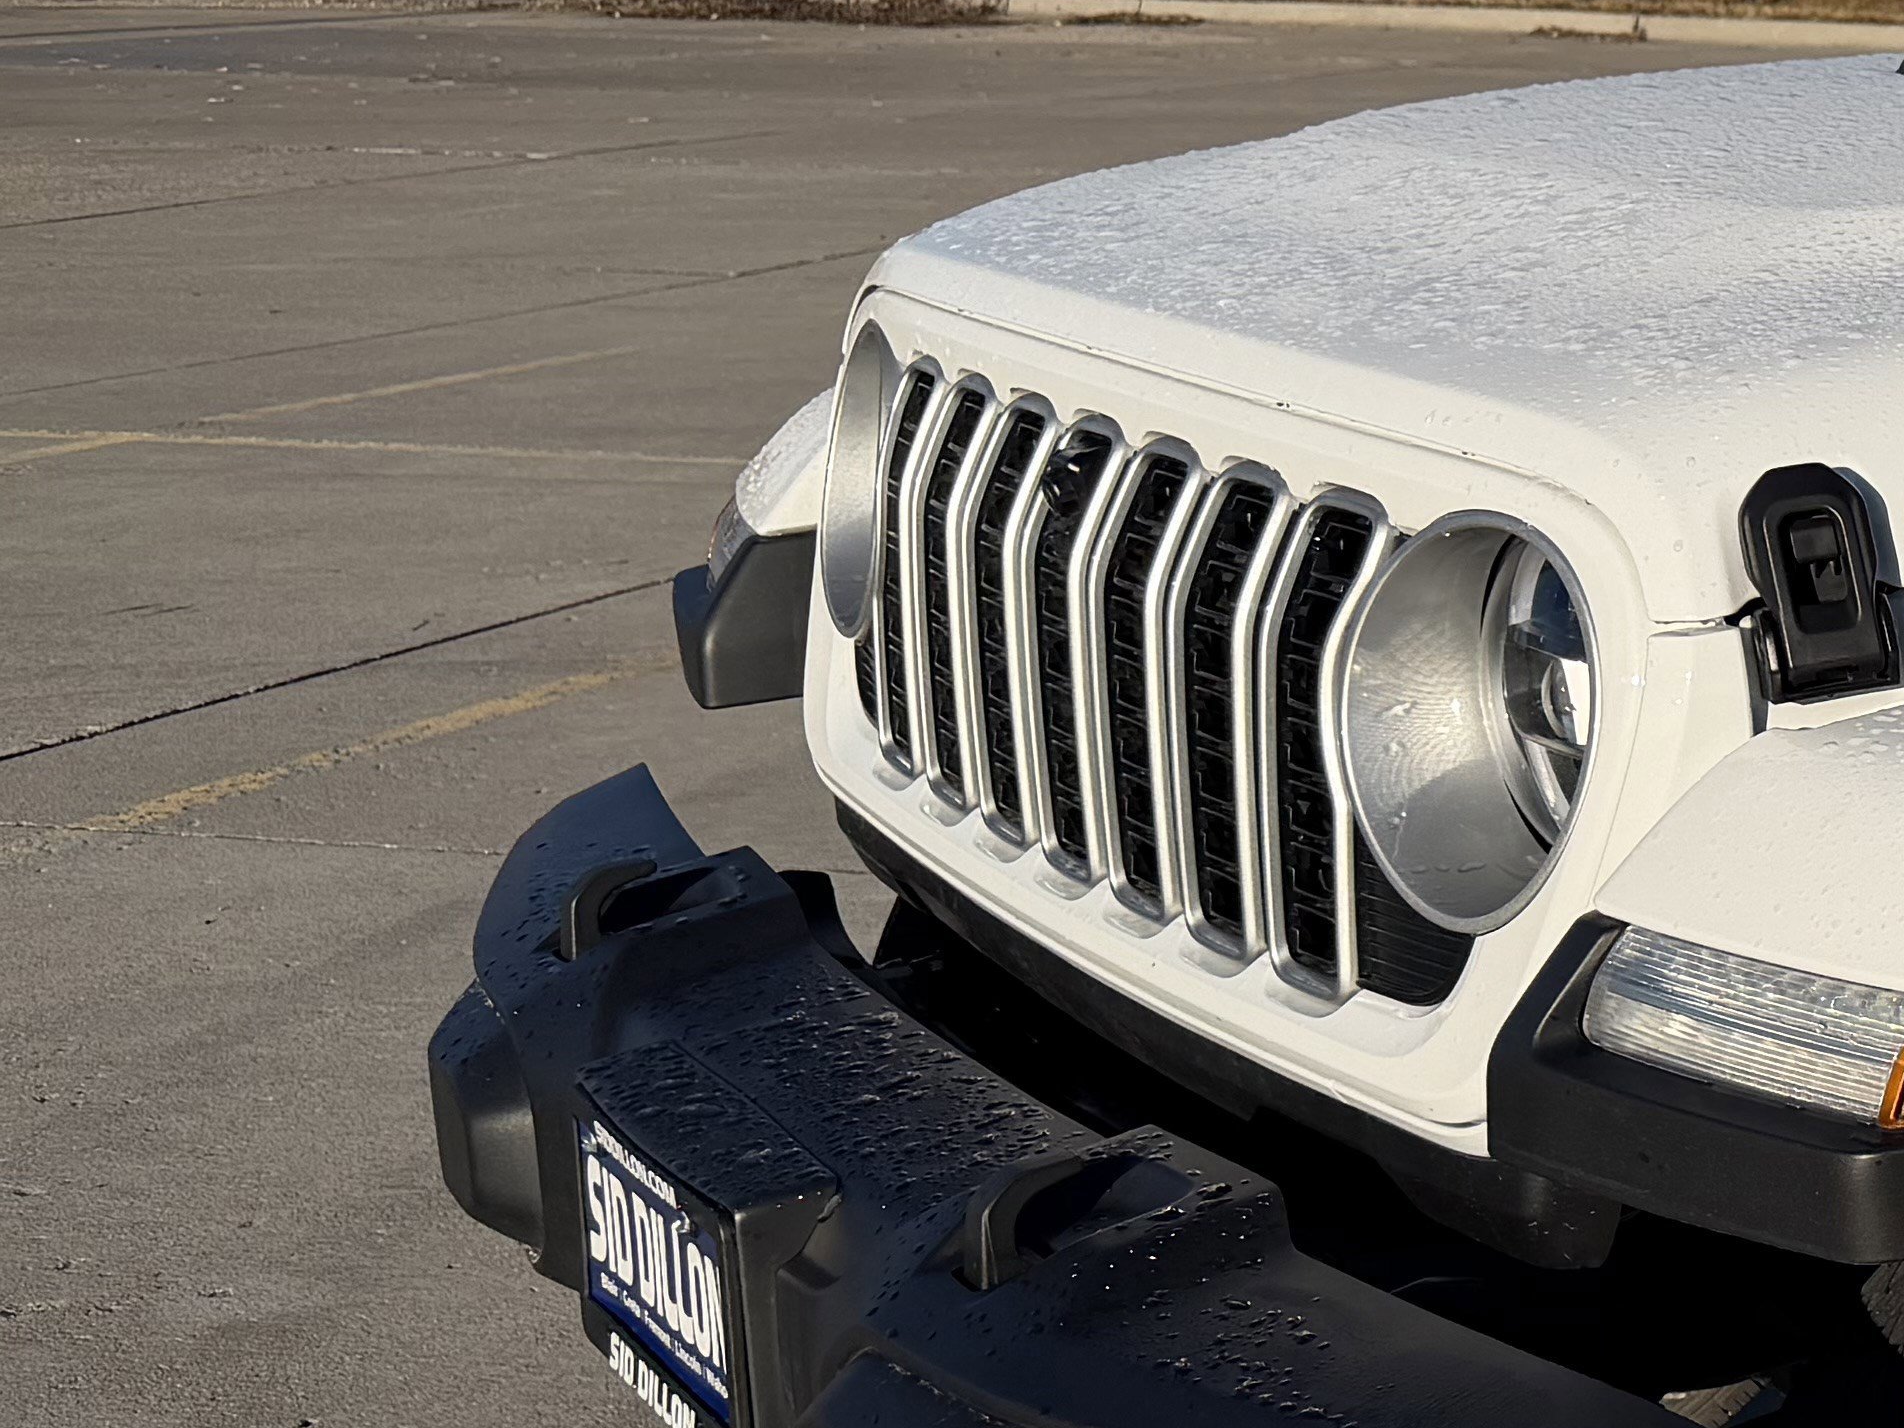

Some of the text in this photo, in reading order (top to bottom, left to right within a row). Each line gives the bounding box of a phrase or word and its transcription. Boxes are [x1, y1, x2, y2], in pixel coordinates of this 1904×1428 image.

[587, 1154, 729, 1375] SID DILLON
[609, 1331, 635, 1387] SID
